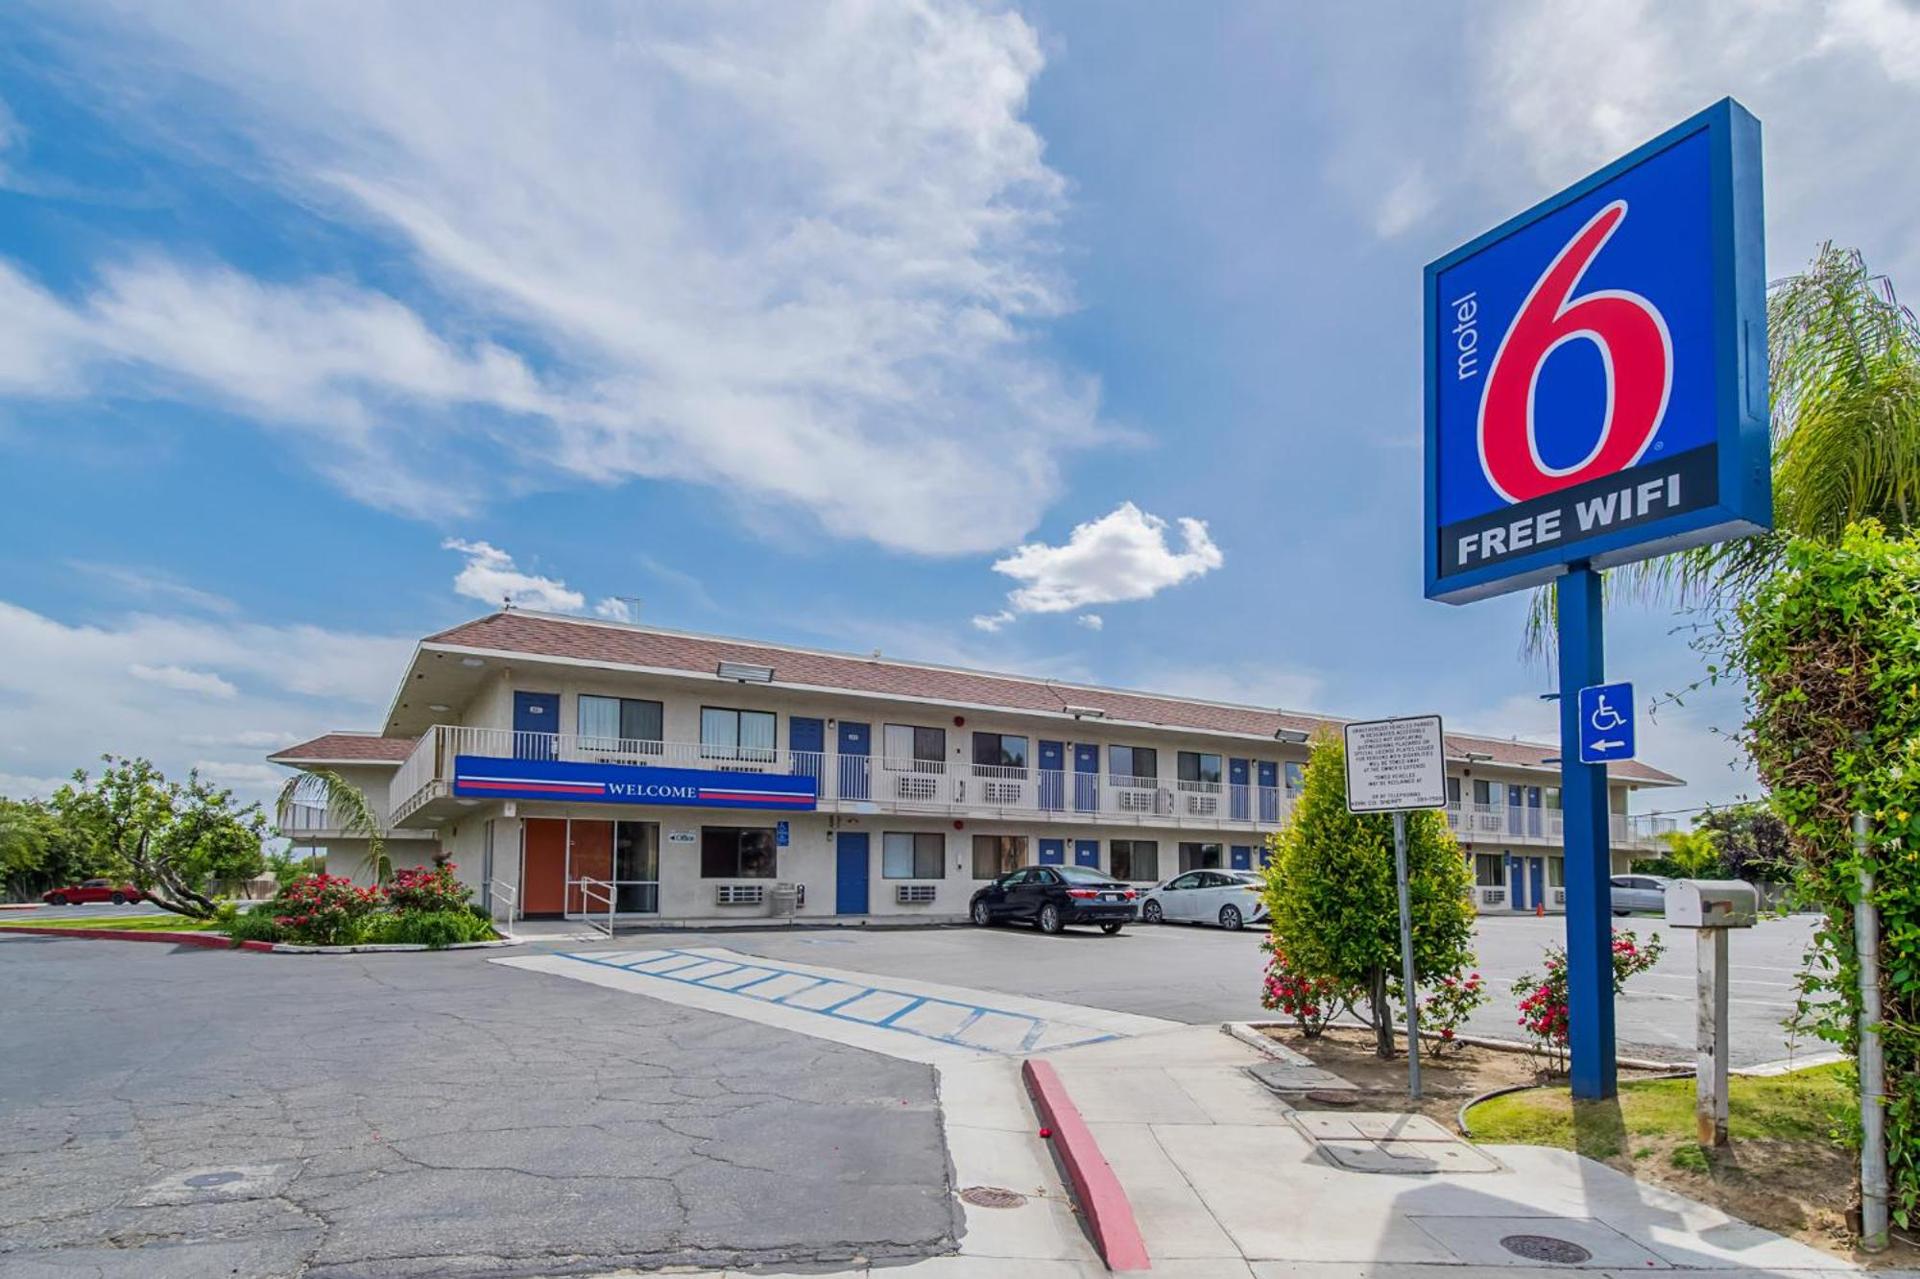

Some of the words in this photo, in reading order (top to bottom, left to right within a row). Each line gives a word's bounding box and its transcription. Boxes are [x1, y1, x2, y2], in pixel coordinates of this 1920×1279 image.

[1452, 291, 1477, 381] motel
[1477, 199, 1674, 505] 6
[1458, 508, 1561, 565] FREE
[1577, 473, 1681, 531] WIFI
[609, 782, 697, 798] WELCOME
